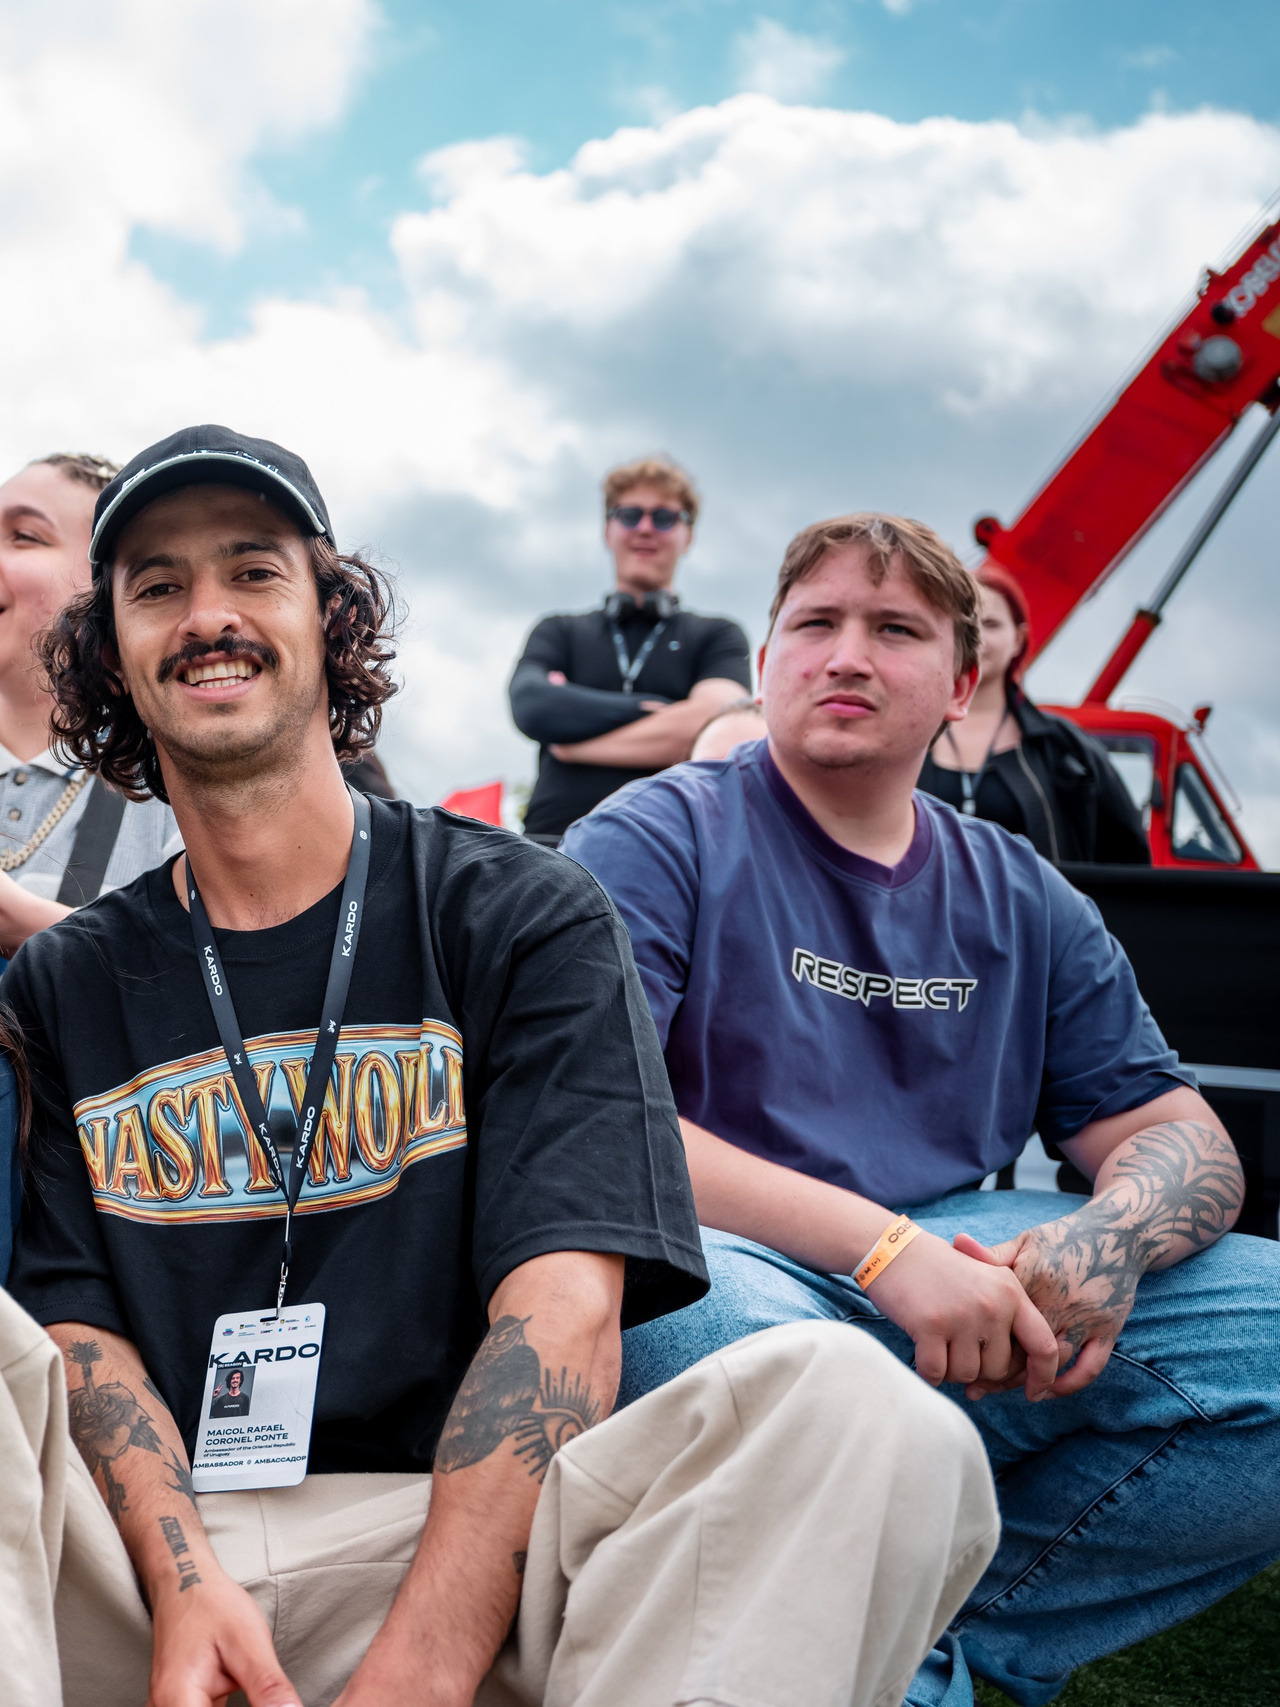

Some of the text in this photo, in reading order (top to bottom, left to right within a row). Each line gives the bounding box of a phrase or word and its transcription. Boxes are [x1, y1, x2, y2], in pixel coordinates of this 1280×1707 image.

[341, 901, 358, 957] KARDO
[203, 945, 223, 996] KARDO
[791, 947, 978, 1013] RESPECT
[77, 1061, 277, 1201] NASTY
[296, 1106, 316, 1169] KARDO
[258, 1122, 282, 1182] KARDO
[888, 1219, 912, 1244] RDO
[209, 1343, 320, 1369] KARDO
[205, 1432, 288, 1446] CORONEL PONTE
[207, 1424, 285, 1437] MAICOL RAFAEL
[193, 1460, 244, 1469] AMBASSADOR
[254, 1455, 307, 1465] АМБАССАДОР
